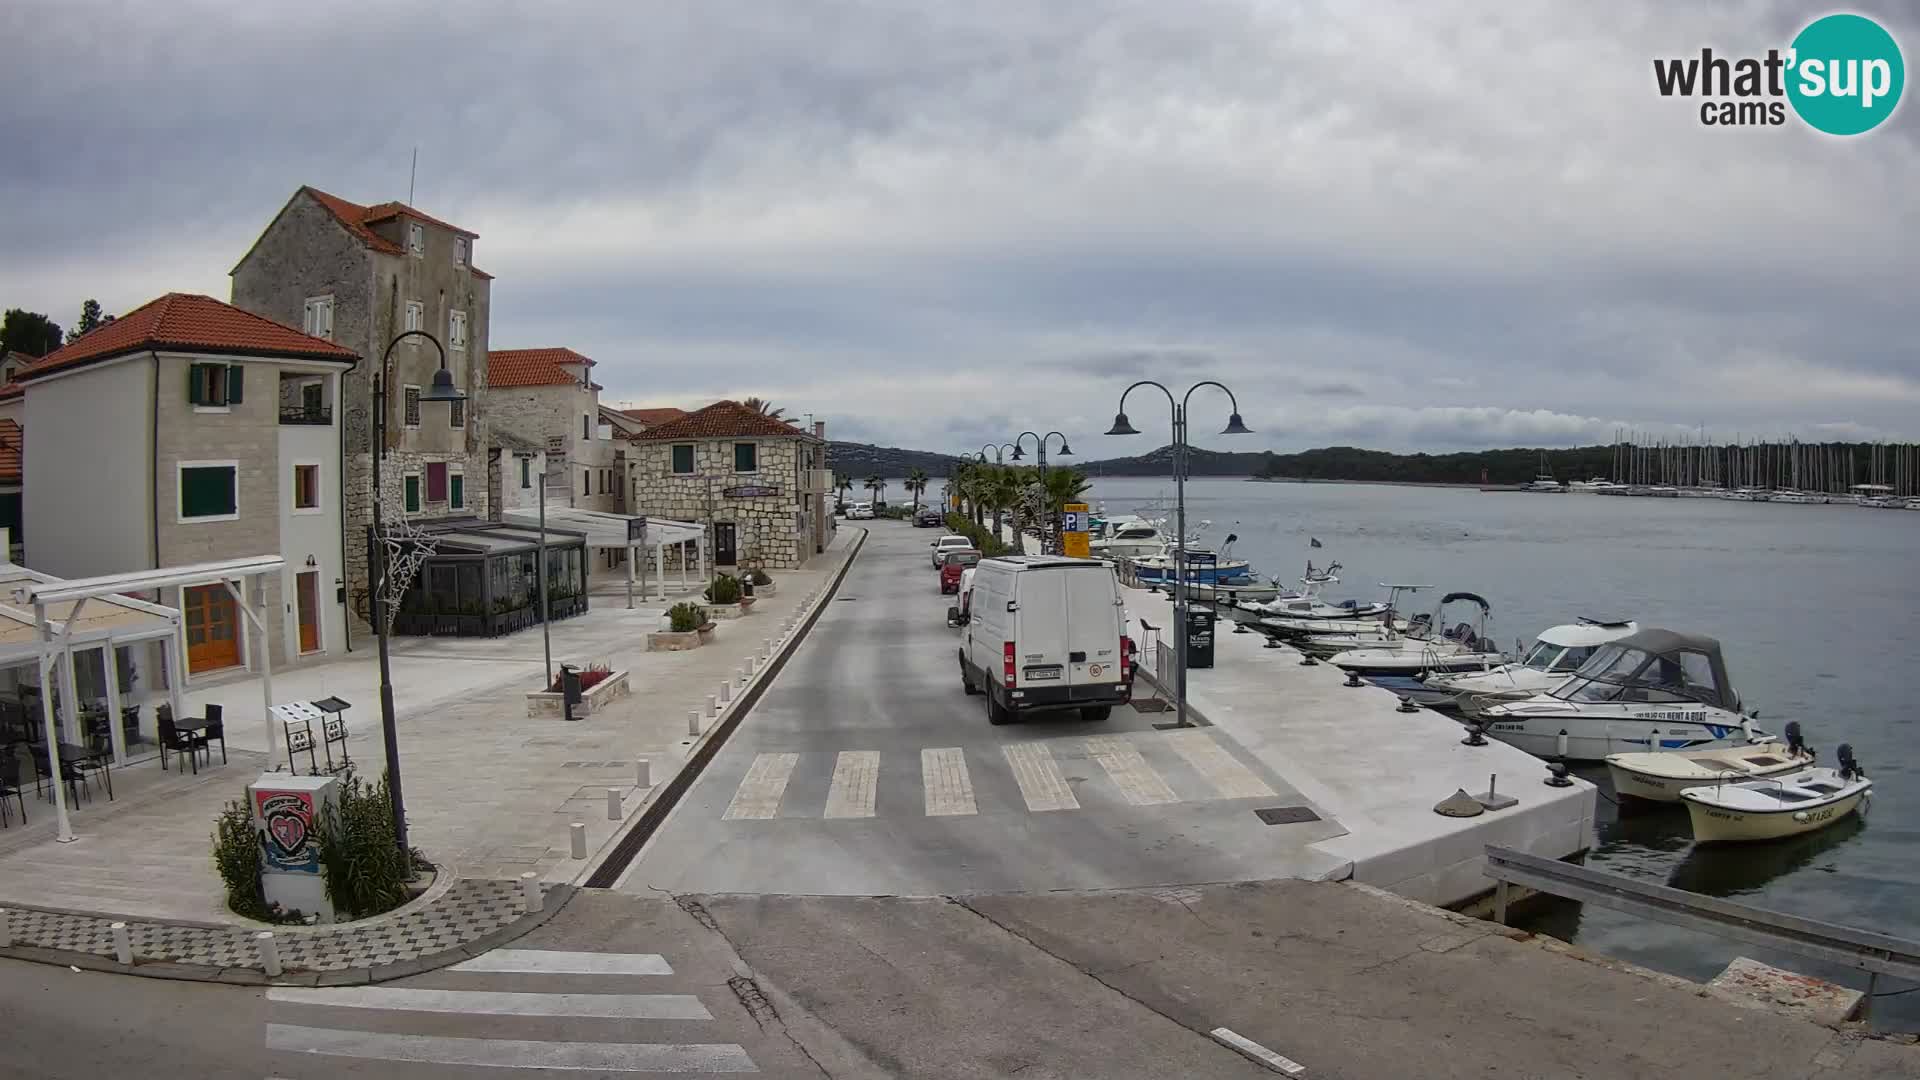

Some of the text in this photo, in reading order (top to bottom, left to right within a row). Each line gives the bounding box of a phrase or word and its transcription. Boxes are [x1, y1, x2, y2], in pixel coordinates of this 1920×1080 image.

[1066, 514, 1076, 530] P
[1667, 711, 1684, 720] RENT
[1691, 711, 1707, 721] BOAT
